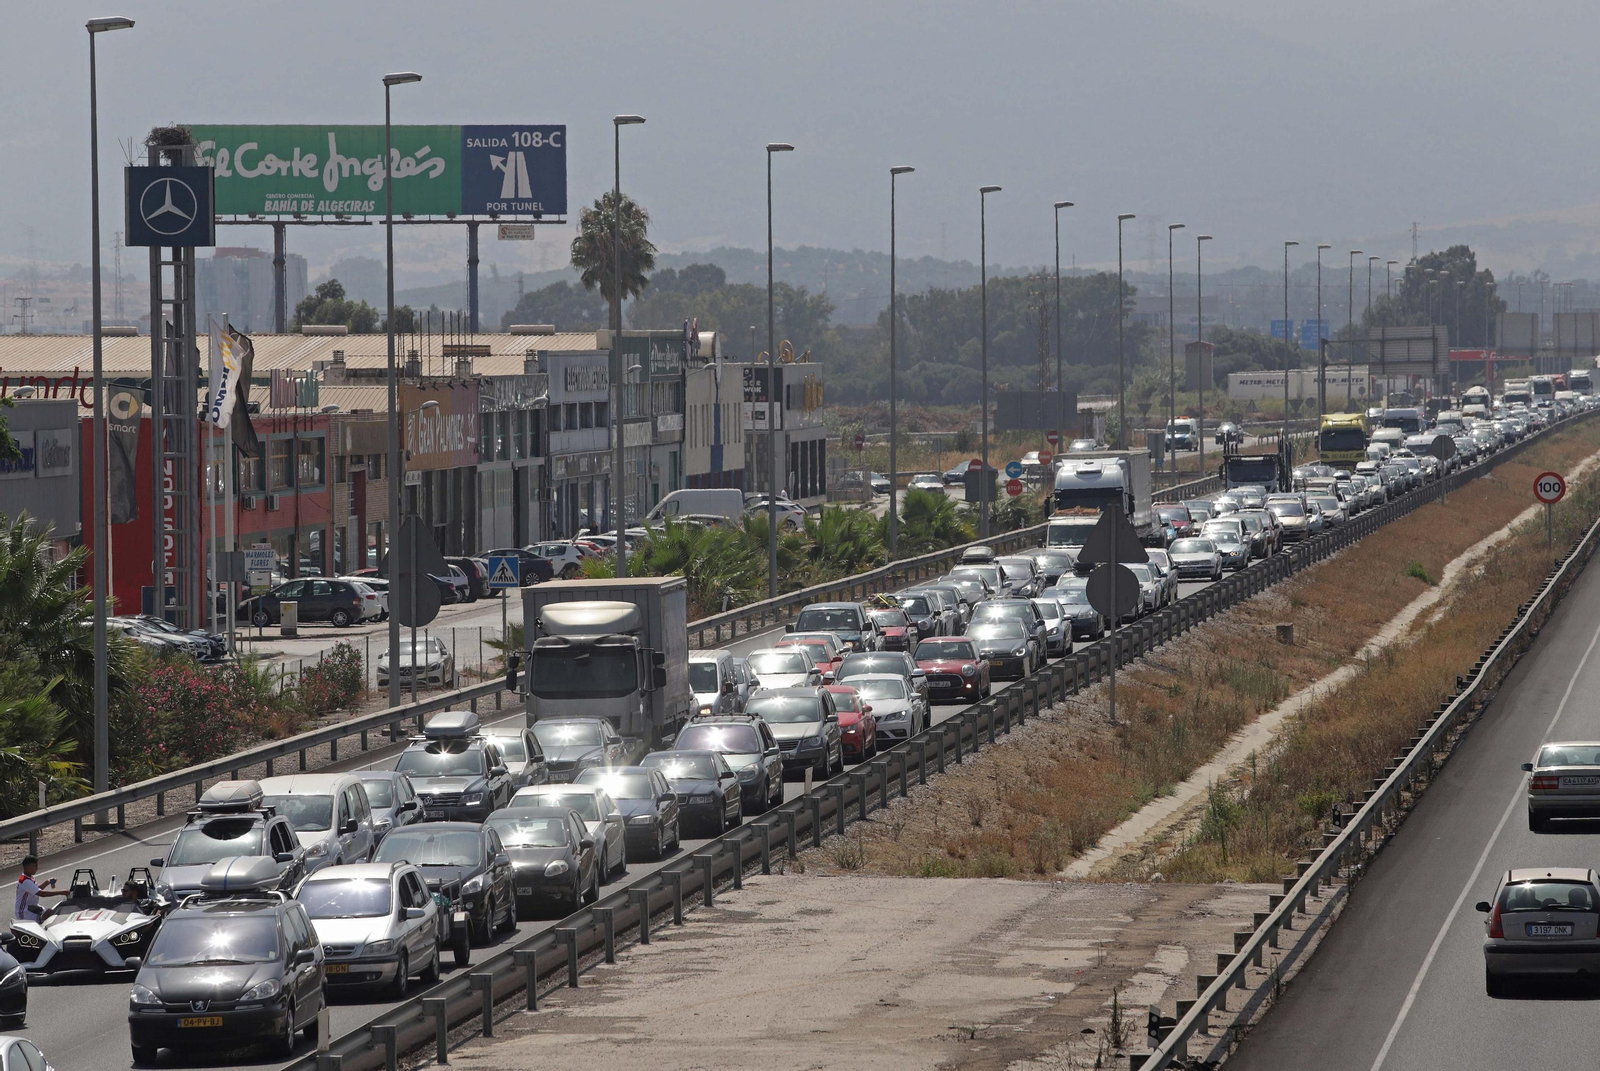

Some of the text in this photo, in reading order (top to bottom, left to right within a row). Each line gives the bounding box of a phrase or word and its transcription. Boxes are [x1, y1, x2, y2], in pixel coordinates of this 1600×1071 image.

[466, 131, 562, 148] SALIDA 108-C
[234, 142, 319, 178] Corte
[323, 131, 446, 193] Inglés
[264, 199, 375, 212] BAHÍA DE ALGECIRAS
[486, 202, 544, 211] POR TUNEL
[108, 423, 136, 434] smart
[1538, 482, 1561, 493] 100
[250, 559, 270, 567] FLORES
[1533, 926, 1568, 934] 3197 DNK
[183, 1017, 220, 1027] 04-PV-BJ
